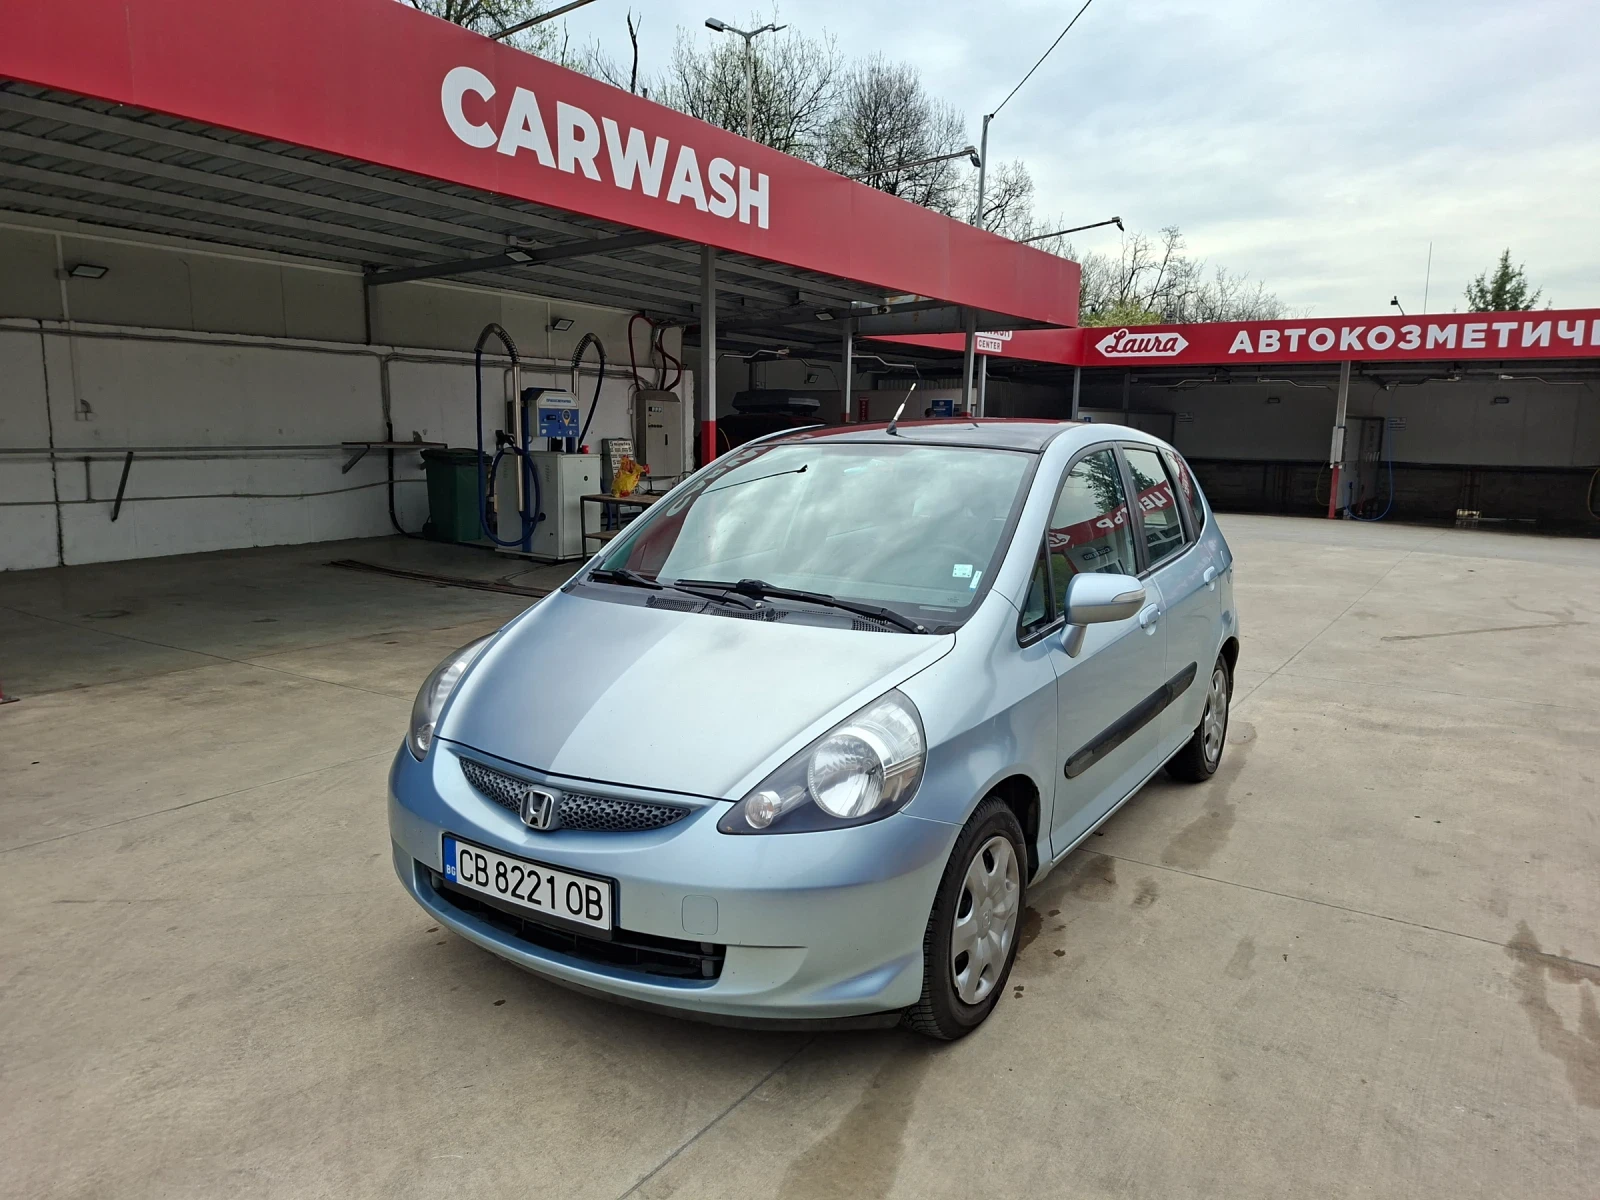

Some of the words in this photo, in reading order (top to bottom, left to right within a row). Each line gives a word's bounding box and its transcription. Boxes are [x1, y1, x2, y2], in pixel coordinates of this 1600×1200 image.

[440, 66, 769, 230] CARWASH
[978, 339, 1001, 350] CENTER
[1104, 330, 1178, 353] Laura
[1228, 319, 1600, 354] АВТОКОЗМЕТИЧ
[446, 864, 456, 876] BG
[495, 861, 556, 910] 8221
